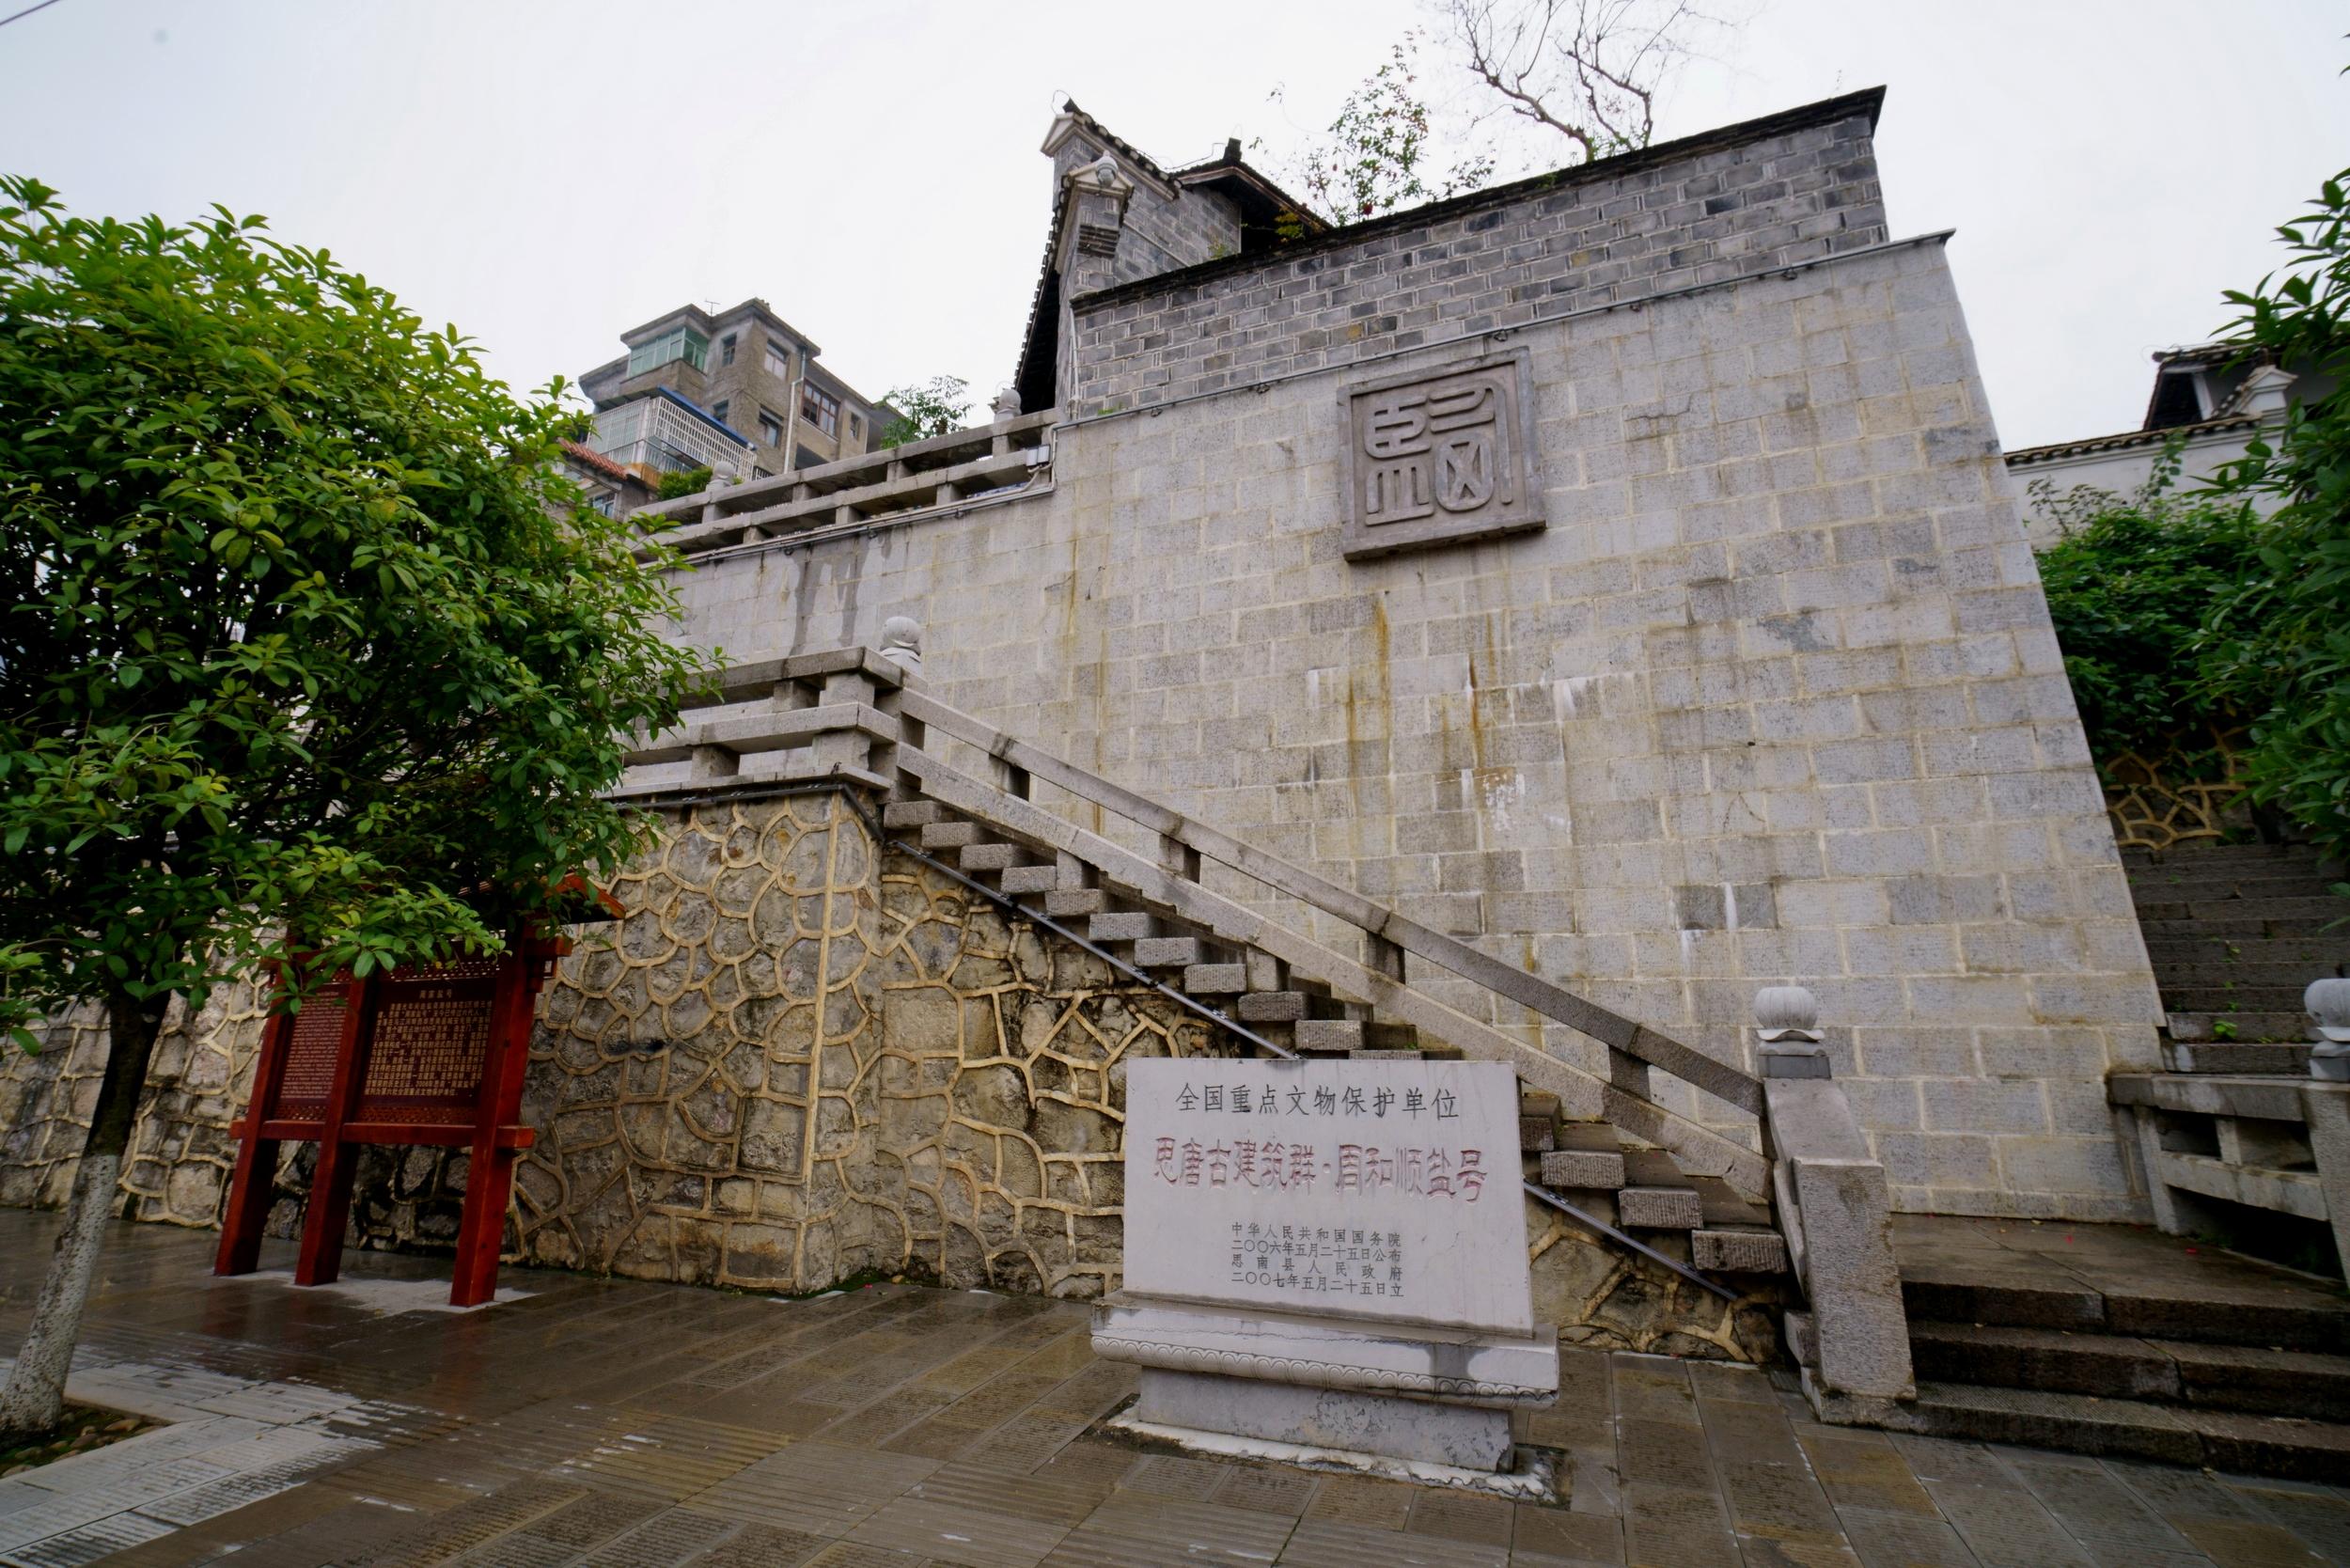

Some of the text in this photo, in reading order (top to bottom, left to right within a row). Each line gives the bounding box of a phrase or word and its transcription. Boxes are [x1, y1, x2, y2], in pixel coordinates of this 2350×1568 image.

[1175, 1083, 1459, 1121] 全国重点文物保护单位
[1232, 1222, 1401, 1247] 中华人民共和国国务院
[1232, 1254, 1402, 1281] 思南县人民政府
